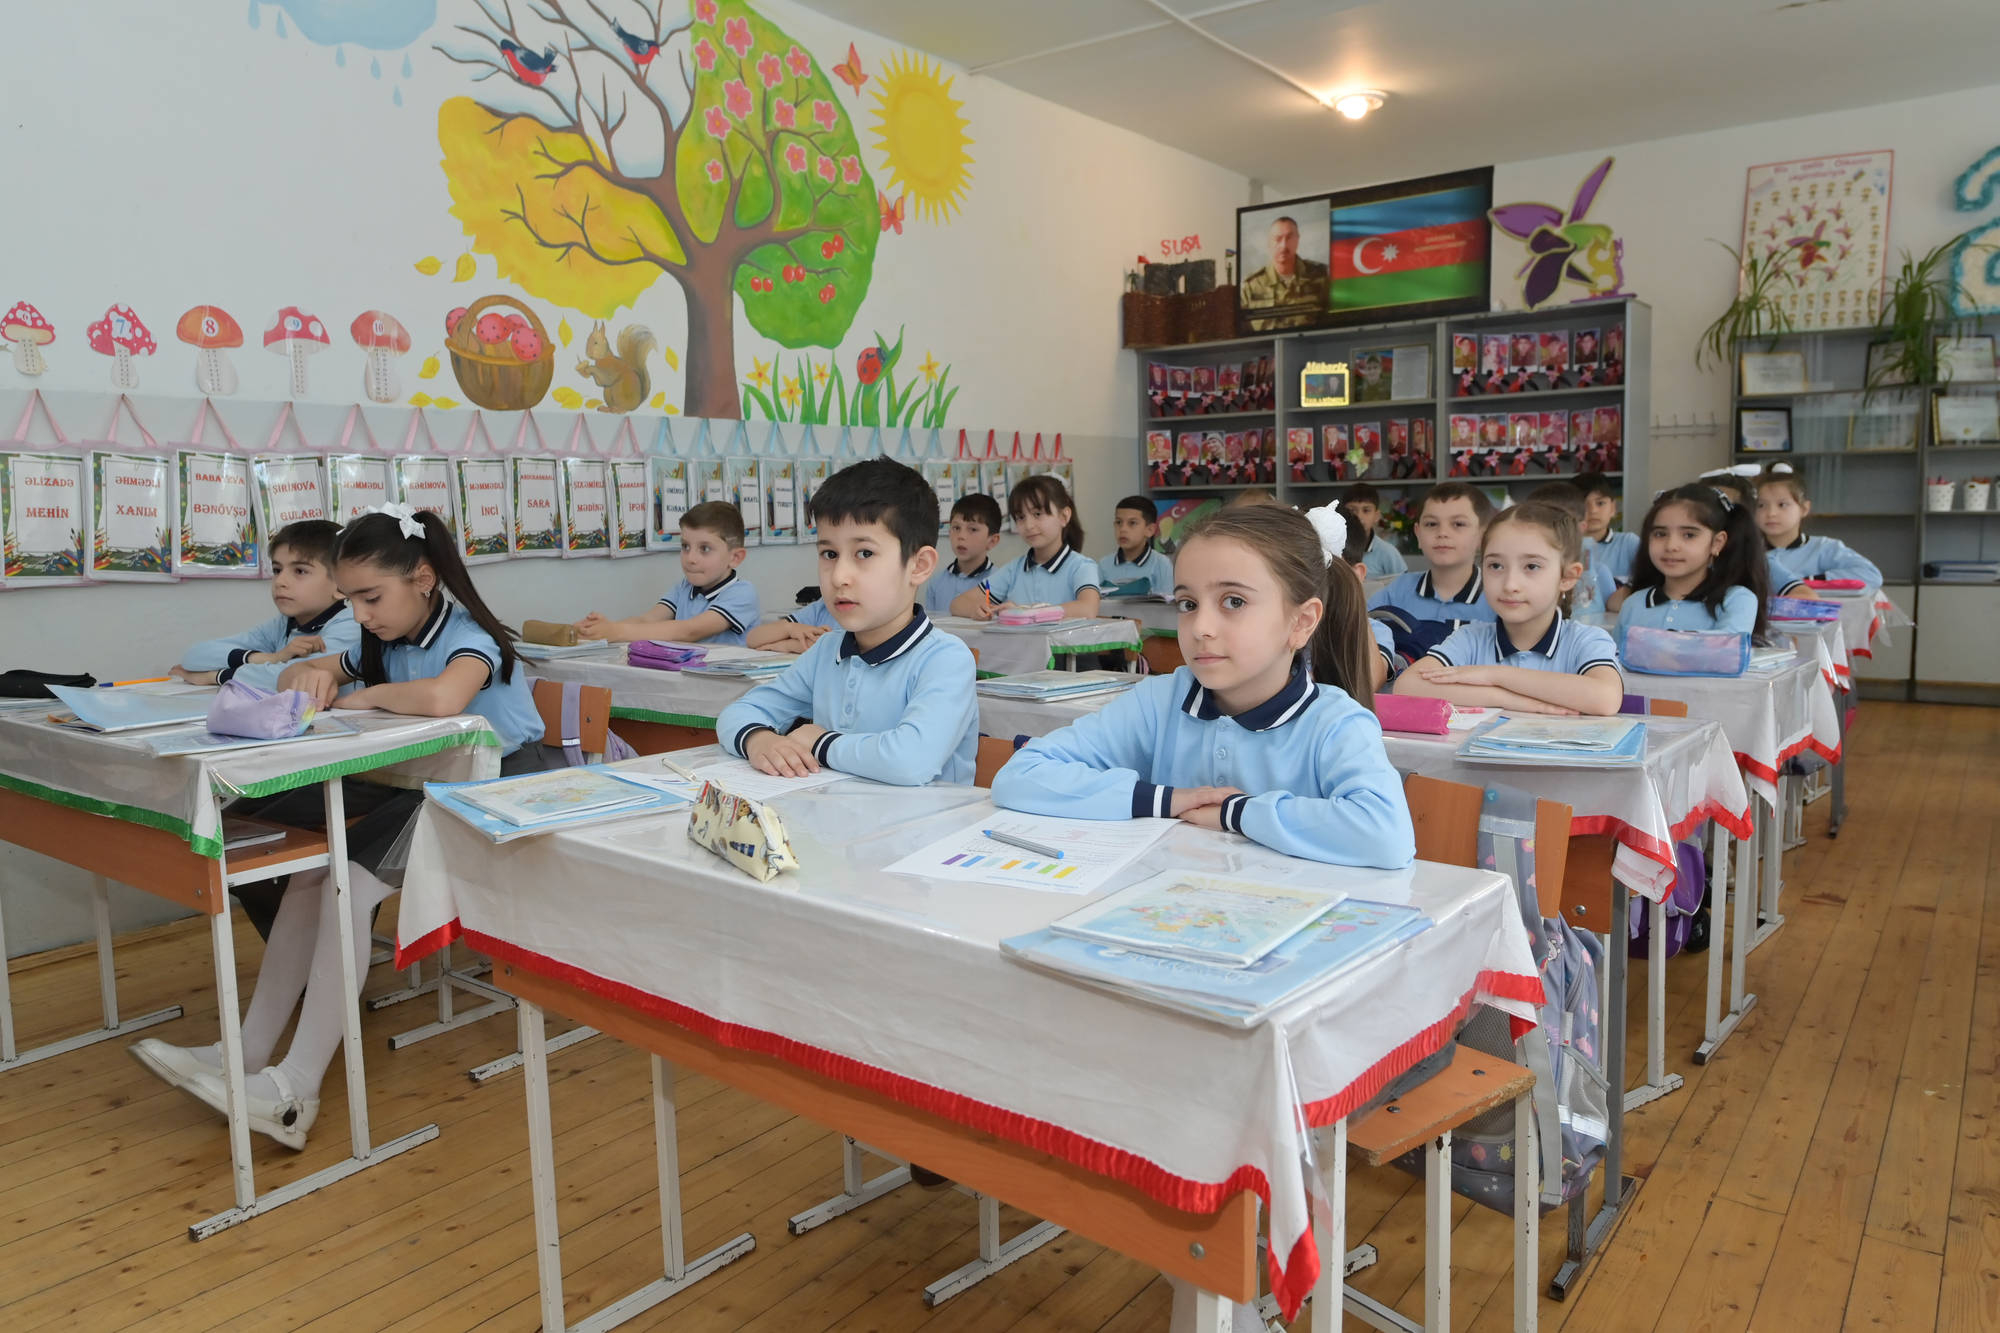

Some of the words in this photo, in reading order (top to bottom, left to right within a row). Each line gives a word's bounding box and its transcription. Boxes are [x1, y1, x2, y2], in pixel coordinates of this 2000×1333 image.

[115, 318, 126, 334] 7
[205, 319, 215, 333] 8
[292, 319, 300, 329] 9
[375, 323, 384, 333] 10
[24, 475, 75, 488] ƏLİZADƏ
[115, 504, 158, 518] XANIM
[193, 503, 248, 518] BƏNÖVŞƏ
[527, 499, 551, 509] SARA
[25, 505, 70, 519] MEHİN
